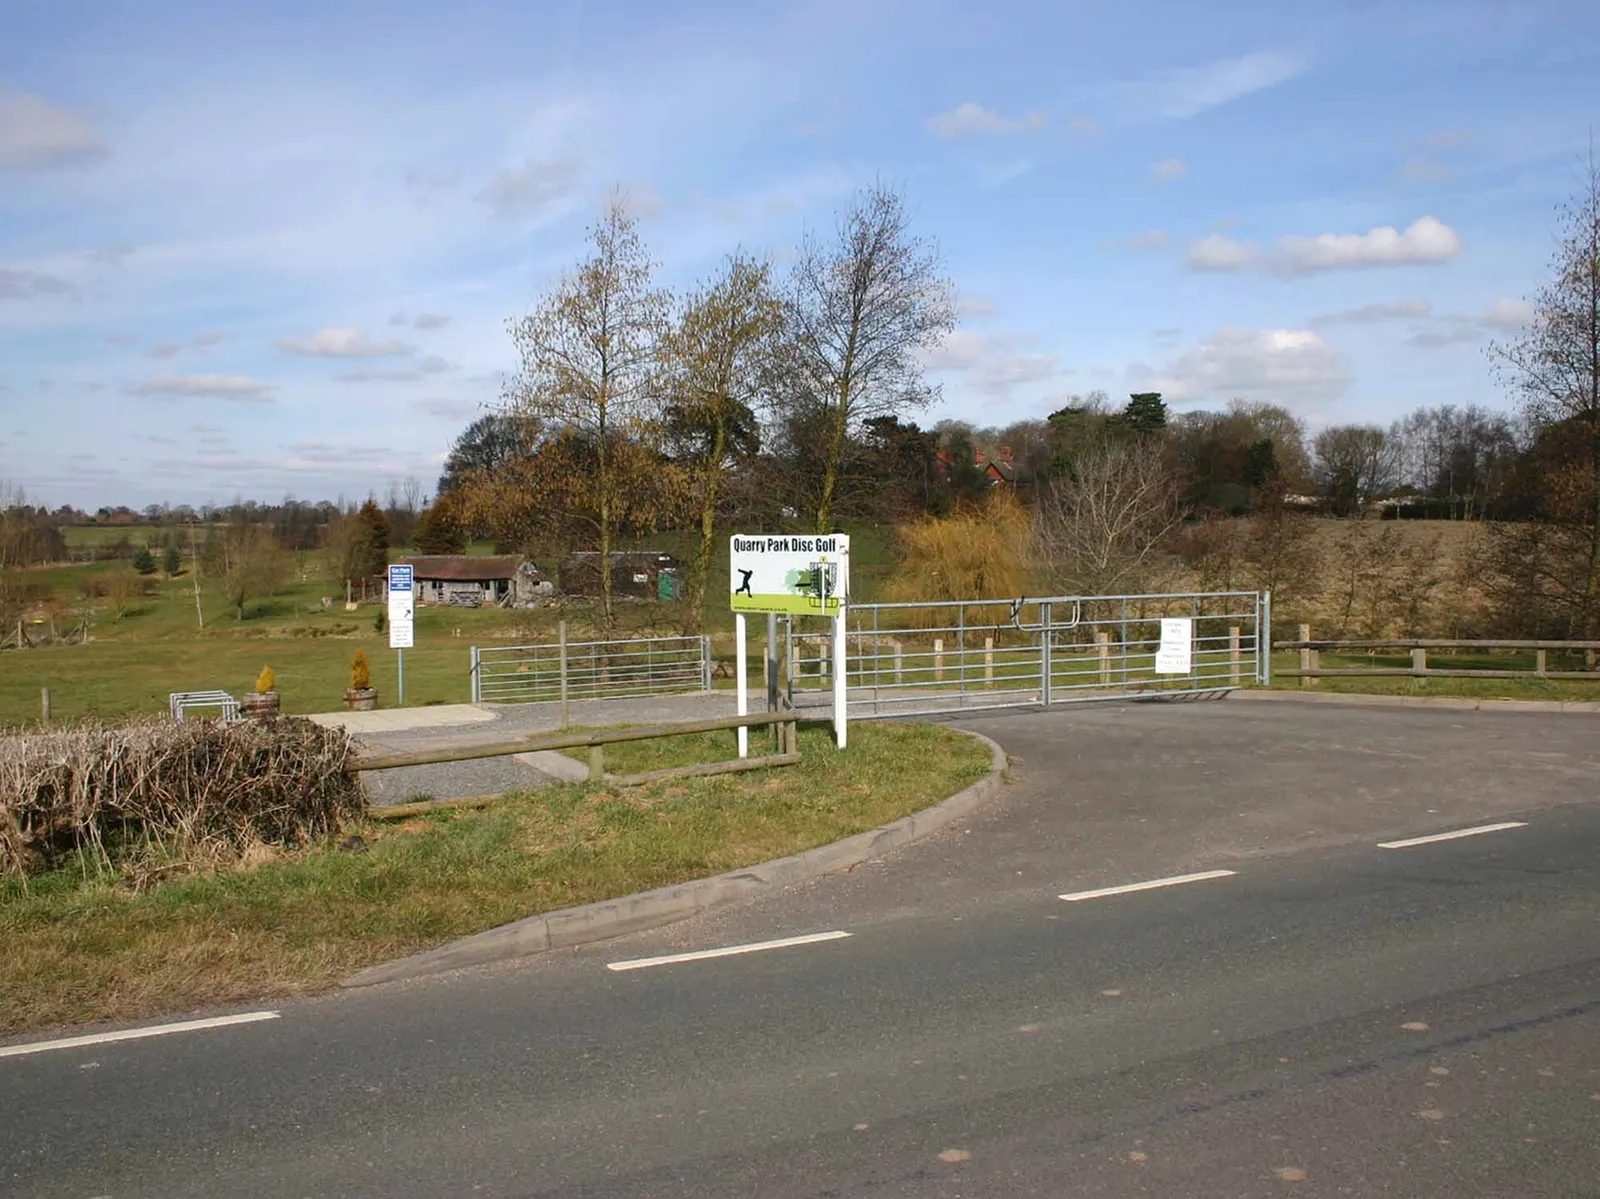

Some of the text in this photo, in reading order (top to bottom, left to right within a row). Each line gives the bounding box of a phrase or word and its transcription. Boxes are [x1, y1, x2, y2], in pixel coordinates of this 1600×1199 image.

[734, 538, 836, 553] Quarry Park Disc Golf
